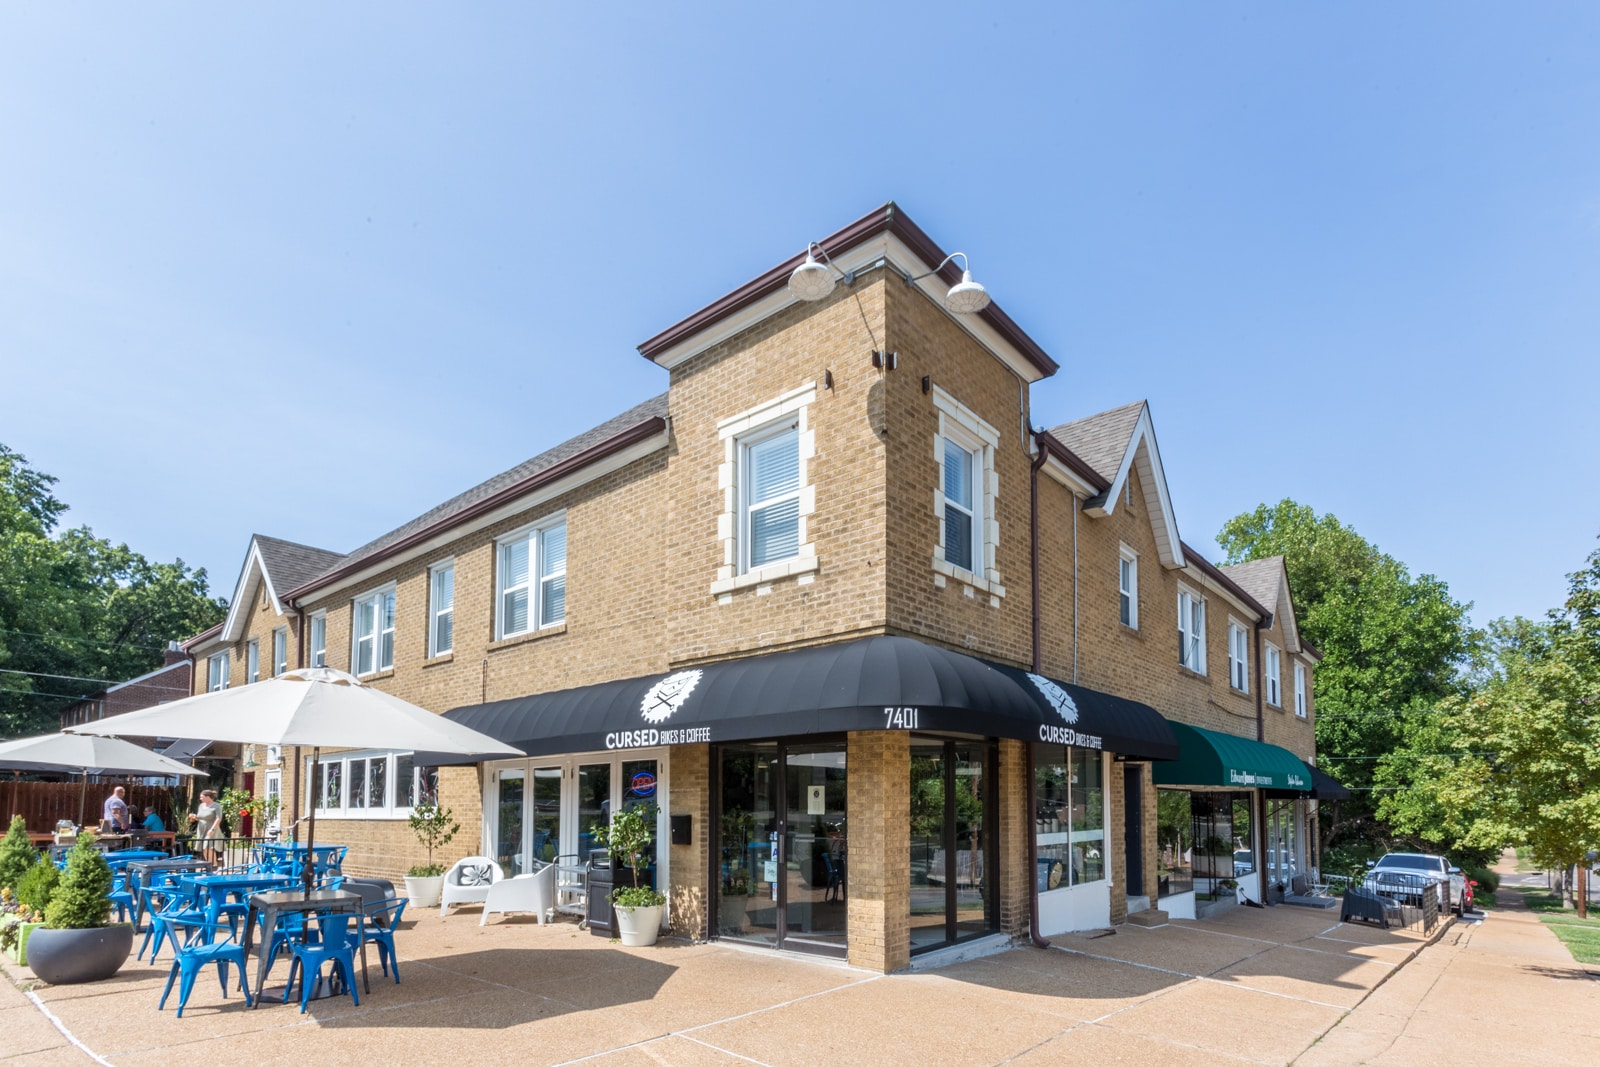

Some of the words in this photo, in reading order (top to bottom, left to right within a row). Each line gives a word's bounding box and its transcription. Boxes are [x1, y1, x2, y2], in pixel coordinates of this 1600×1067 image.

[884, 707, 918, 729] 7401
[606, 729, 659, 748] CURSED
[661, 730, 678, 744] BIKES
[680, 729, 685, 744] &
[686, 727, 710, 743] COFFEE
[1039, 724, 1075, 745] CURSED
[631, 775, 655, 790] OPEN
